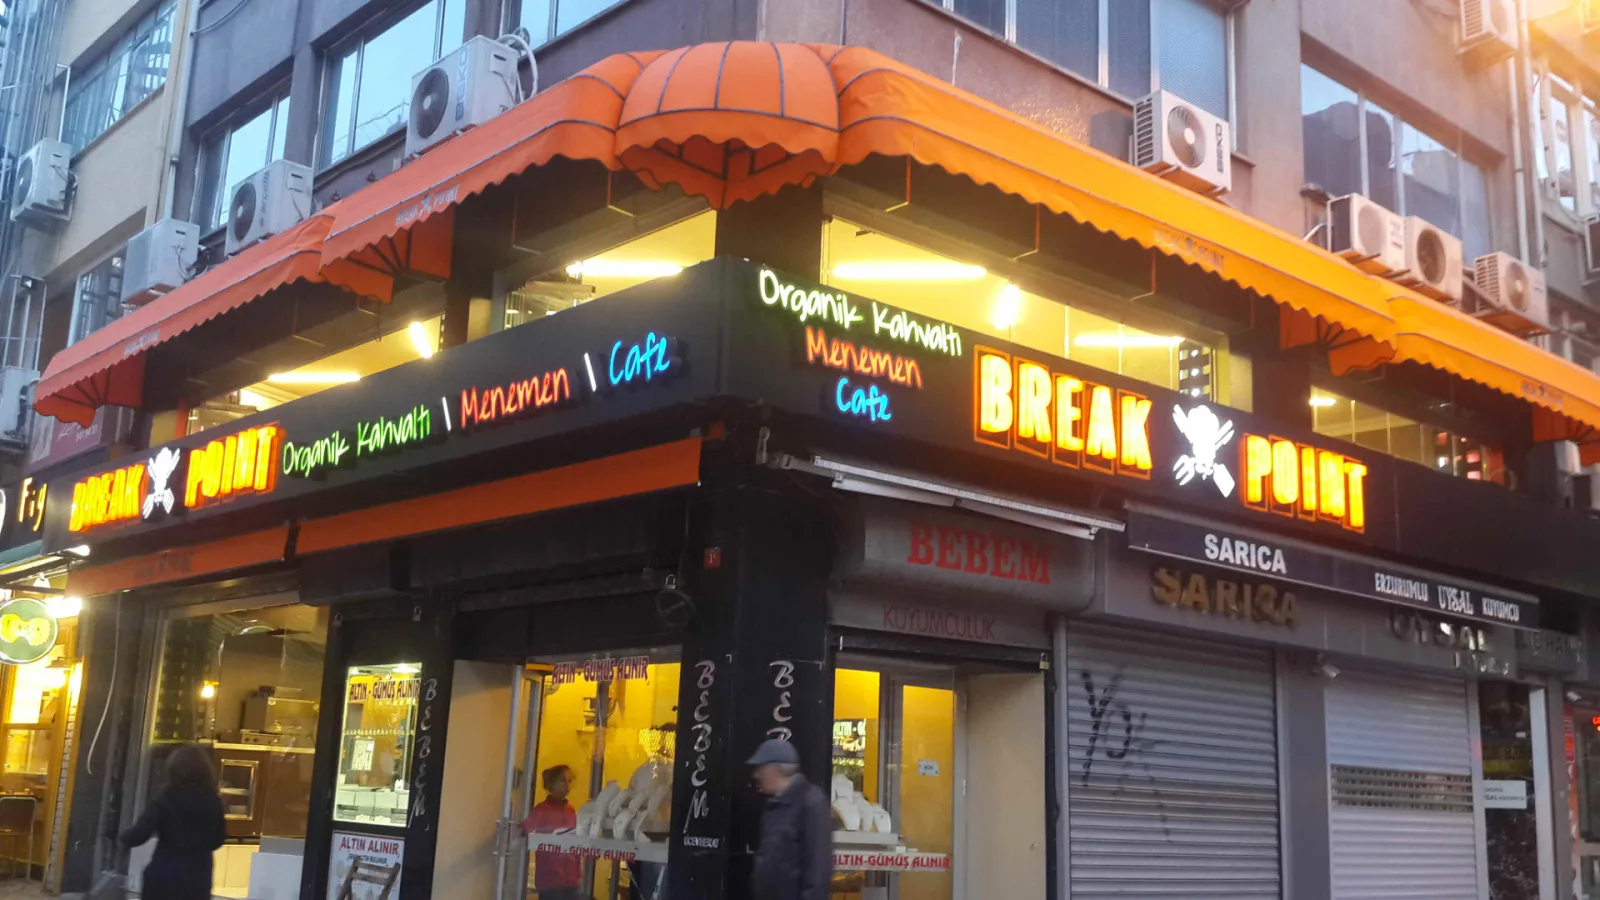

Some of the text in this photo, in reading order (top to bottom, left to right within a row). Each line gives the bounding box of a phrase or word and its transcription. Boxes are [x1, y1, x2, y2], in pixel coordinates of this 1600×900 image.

[759, 269, 864, 329] Organik
[805, 326, 923, 388] Menemen
[283, 430, 350, 477] Organik
[460, 367, 570, 429] Menemen
[608, 331, 671, 385] Cafe
[836, 377, 892, 421] Cafe
[975, 349, 1368, 531] BREAK POINT
[69, 463, 146, 532] BREAK
[185, 425, 282, 507] POINT
[907, 519, 1051, 585] BEBEM
[1203, 533, 1287, 575] SARICA
[883, 605, 996, 641] KUYUMCULUK
[1151, 567, 1301, 627] SARICA
[1374, 572, 1520, 622] ERZURUMLU UYSAL KUYUMCU
[683, 660, 716, 834] BEBEM
[341, 836, 399, 856] ALTIN ALINIR
